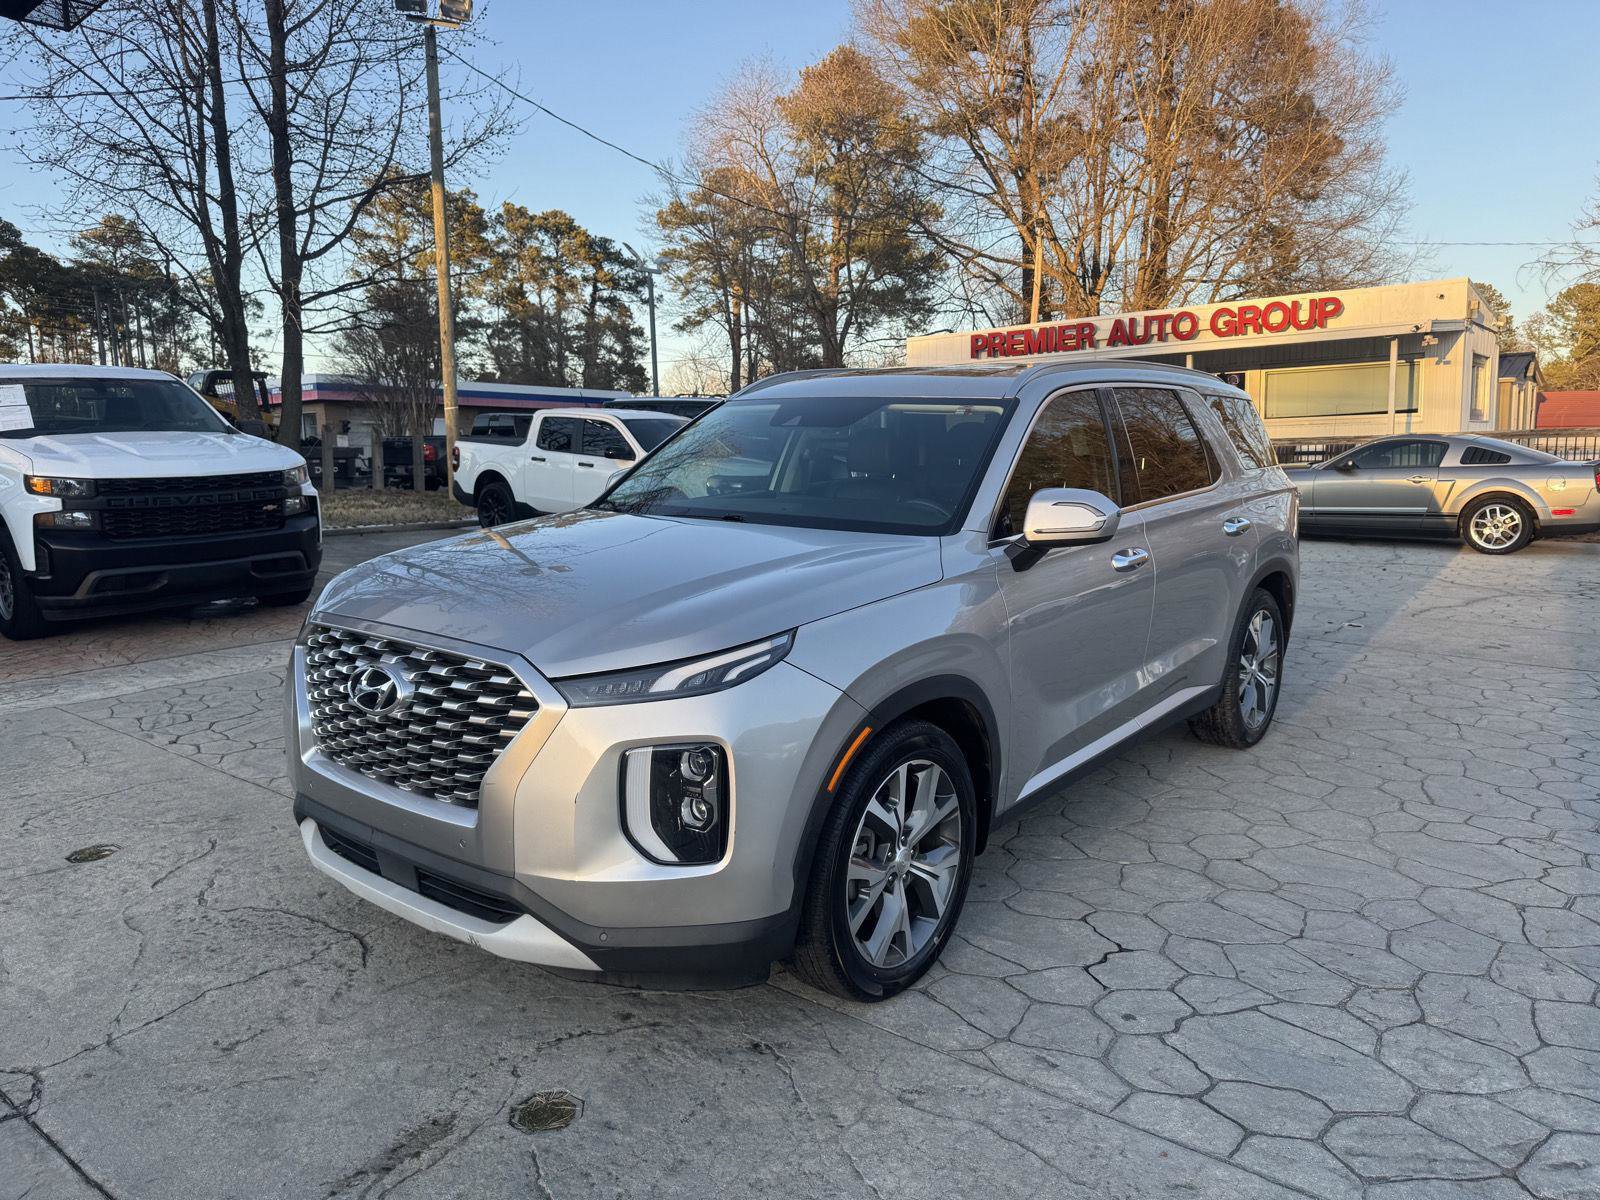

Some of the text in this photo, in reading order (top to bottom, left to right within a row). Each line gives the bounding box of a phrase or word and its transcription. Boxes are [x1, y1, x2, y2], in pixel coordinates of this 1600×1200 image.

[971, 297, 1343, 358] PREMIER AUTO GROUP
[106, 488, 285, 509] CHEVROLET
